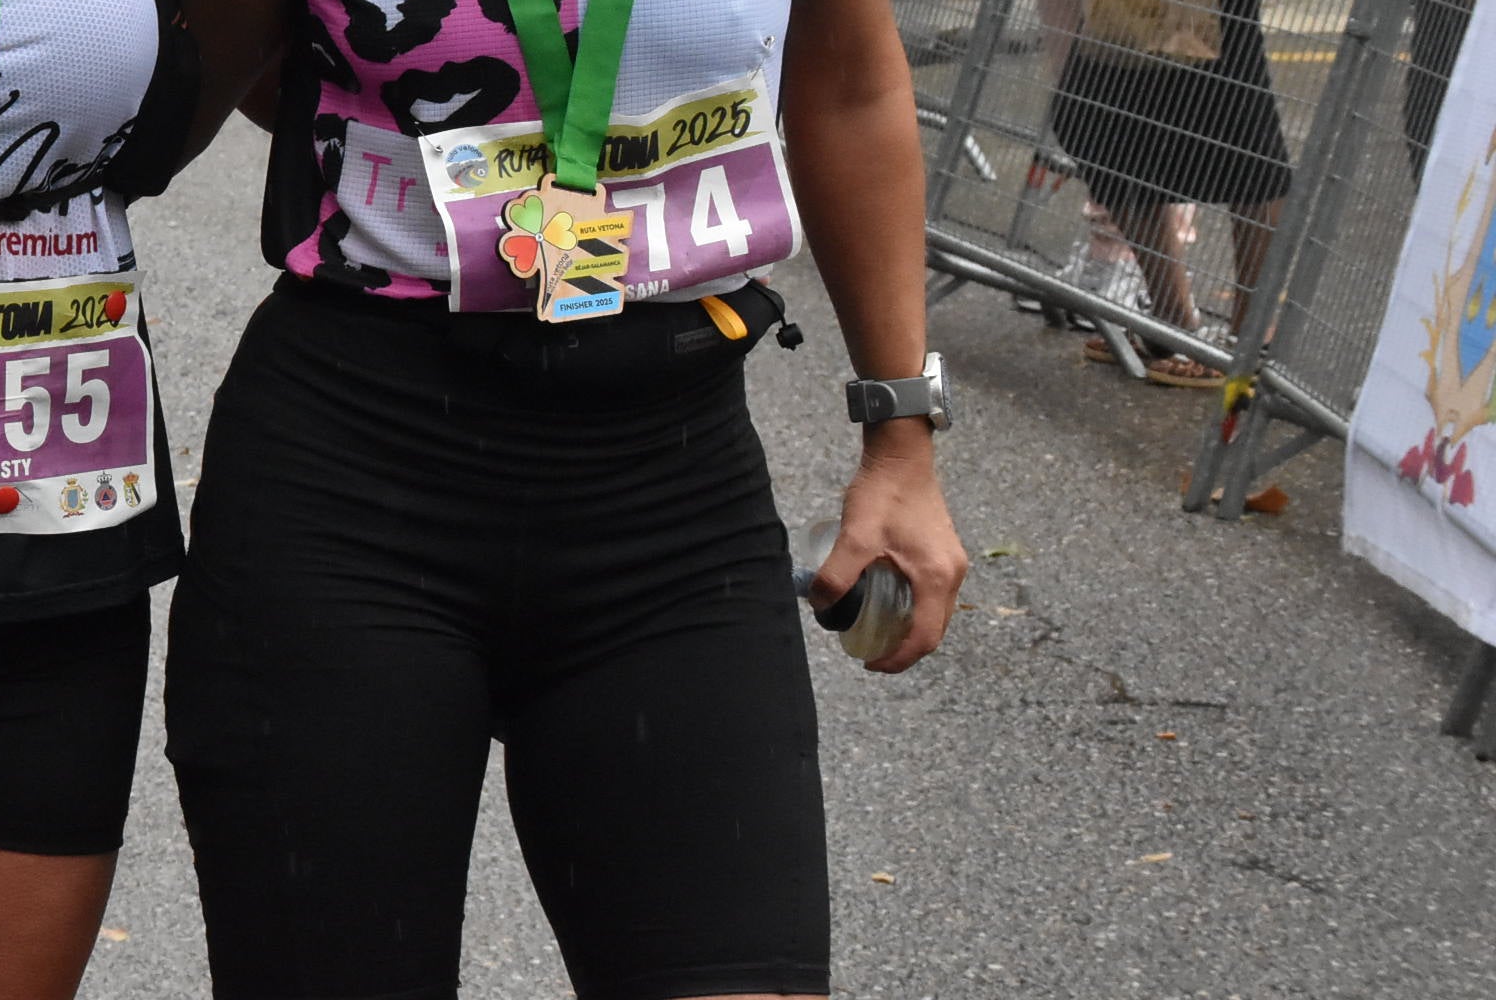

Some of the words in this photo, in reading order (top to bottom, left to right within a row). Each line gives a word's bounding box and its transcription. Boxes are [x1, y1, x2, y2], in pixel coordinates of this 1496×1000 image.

[597, 130, 659, 172] TONA
[666, 97, 753, 157] 2025
[362, 152, 418, 213] Tr
[580, 226, 597, 235] RUTA
[599, 222, 625, 232] VETONA
[611, 165, 753, 272] 74
[560, 301, 593, 312] FINISHER
[595, 297, 614, 308] 2025
[626, 278, 671, 300] SANA
[59, 292, 117, 333] 202
